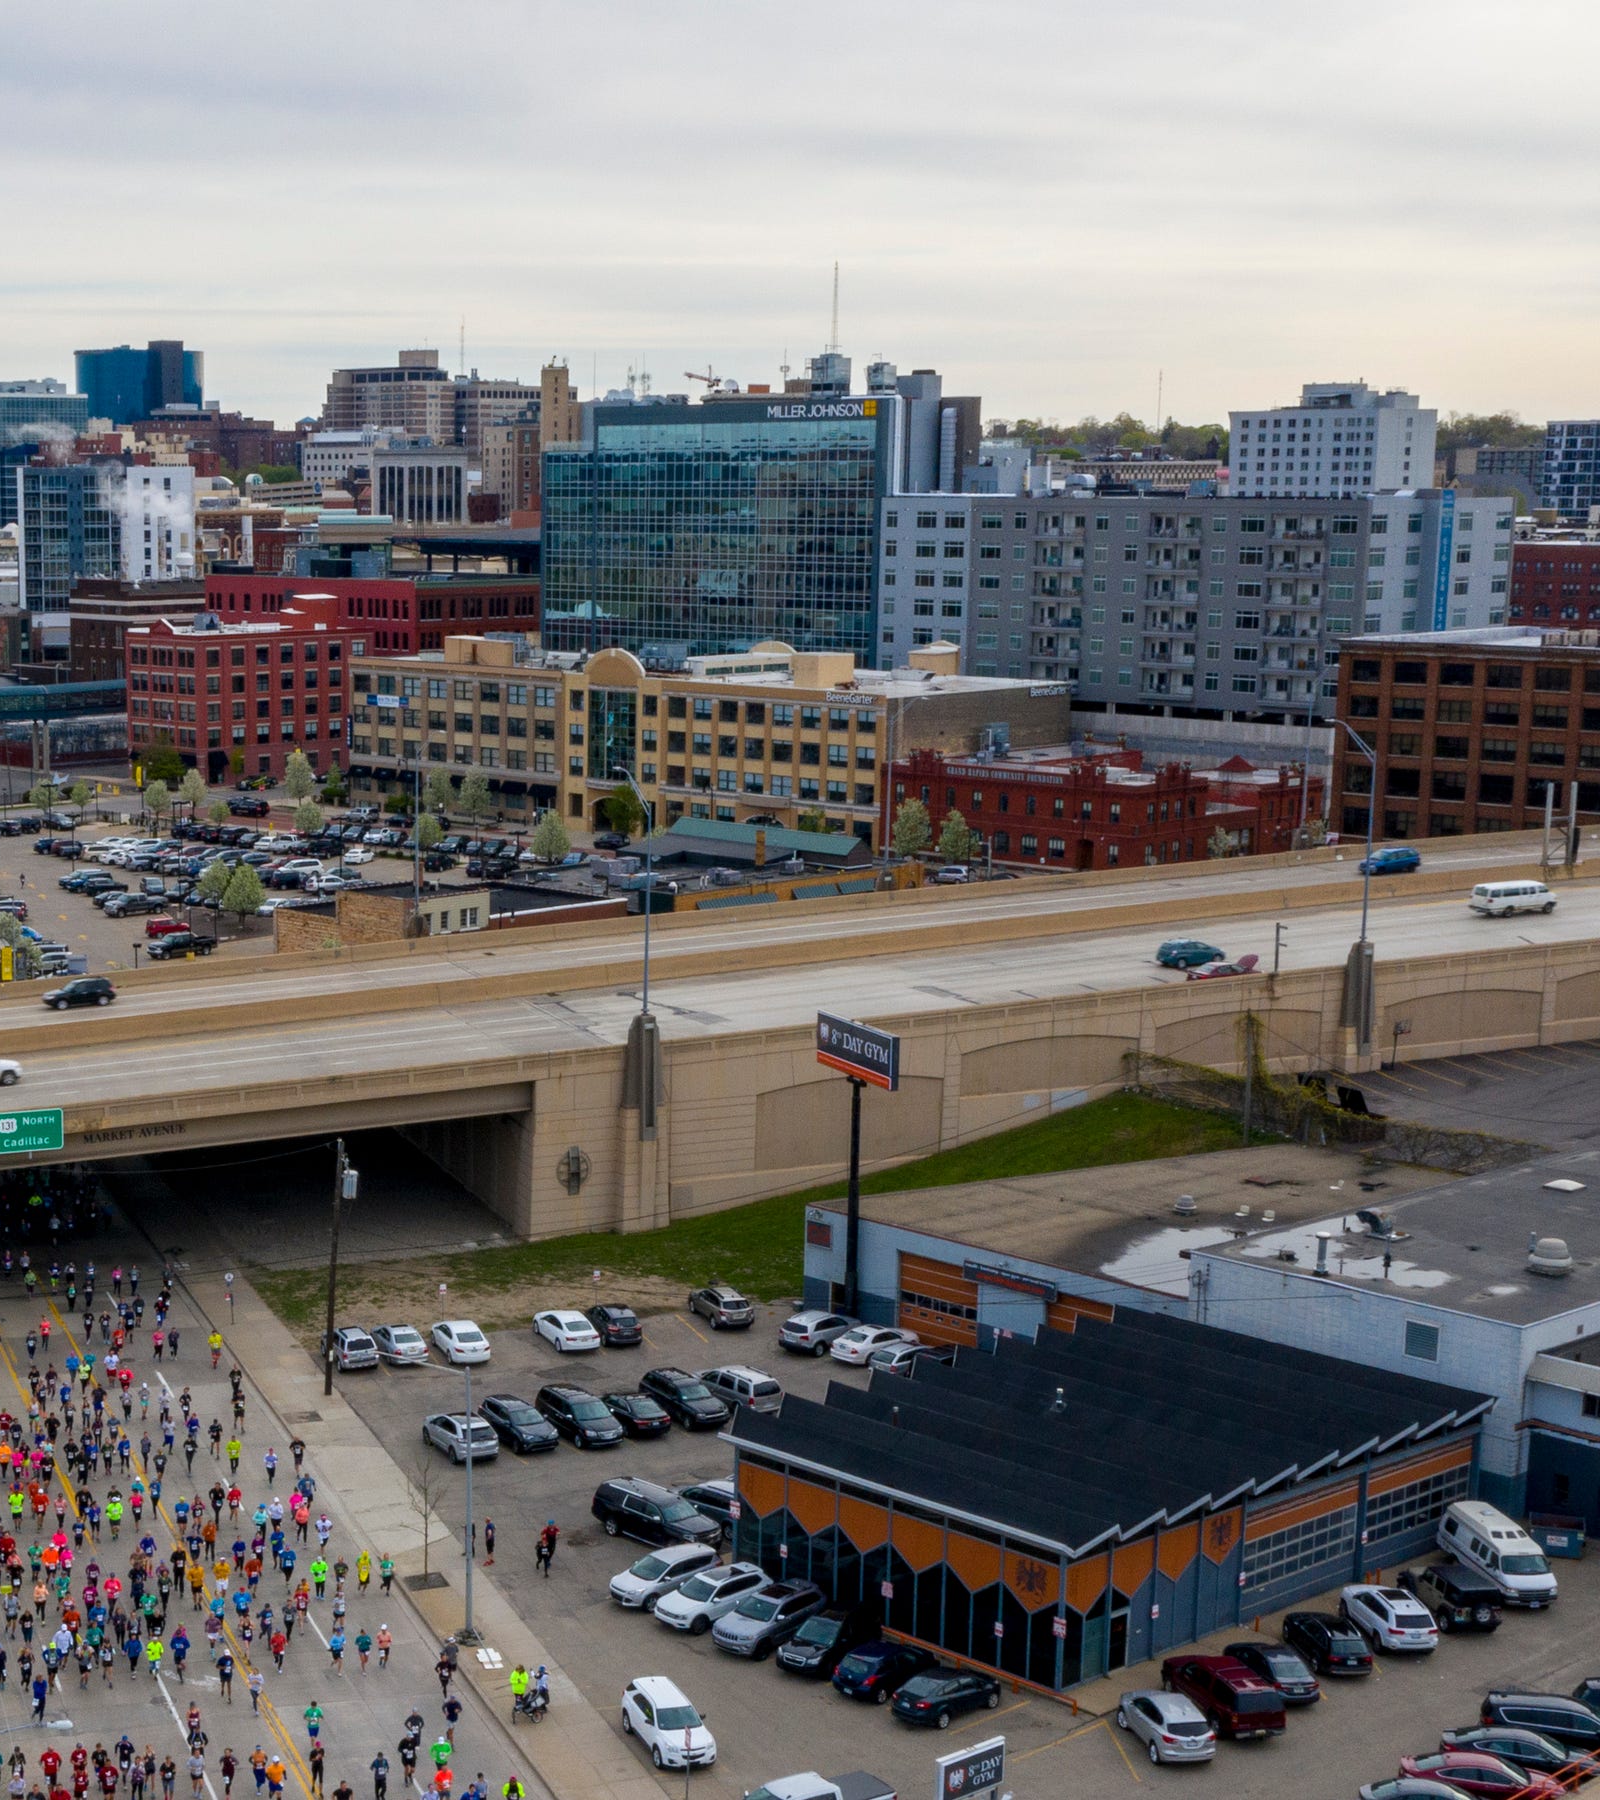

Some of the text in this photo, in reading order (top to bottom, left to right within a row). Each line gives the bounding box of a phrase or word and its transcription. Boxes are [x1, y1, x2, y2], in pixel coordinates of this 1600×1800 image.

[767, 403, 864, 418] MILLER JOHNSON
[825, 691, 873, 704] BeeneGarter
[843, 1033, 863, 1054] DAY
[864, 1041, 888, 1064] GYM
[1, 1116, 55, 1131] 131 NORTH
[3, 1136, 50, 1147] Cadillac
[83, 1124, 186, 1144] MARKET AVENUE
[980, 1755, 1002, 1772] DAY
[972, 1769, 995, 1785] GYM
